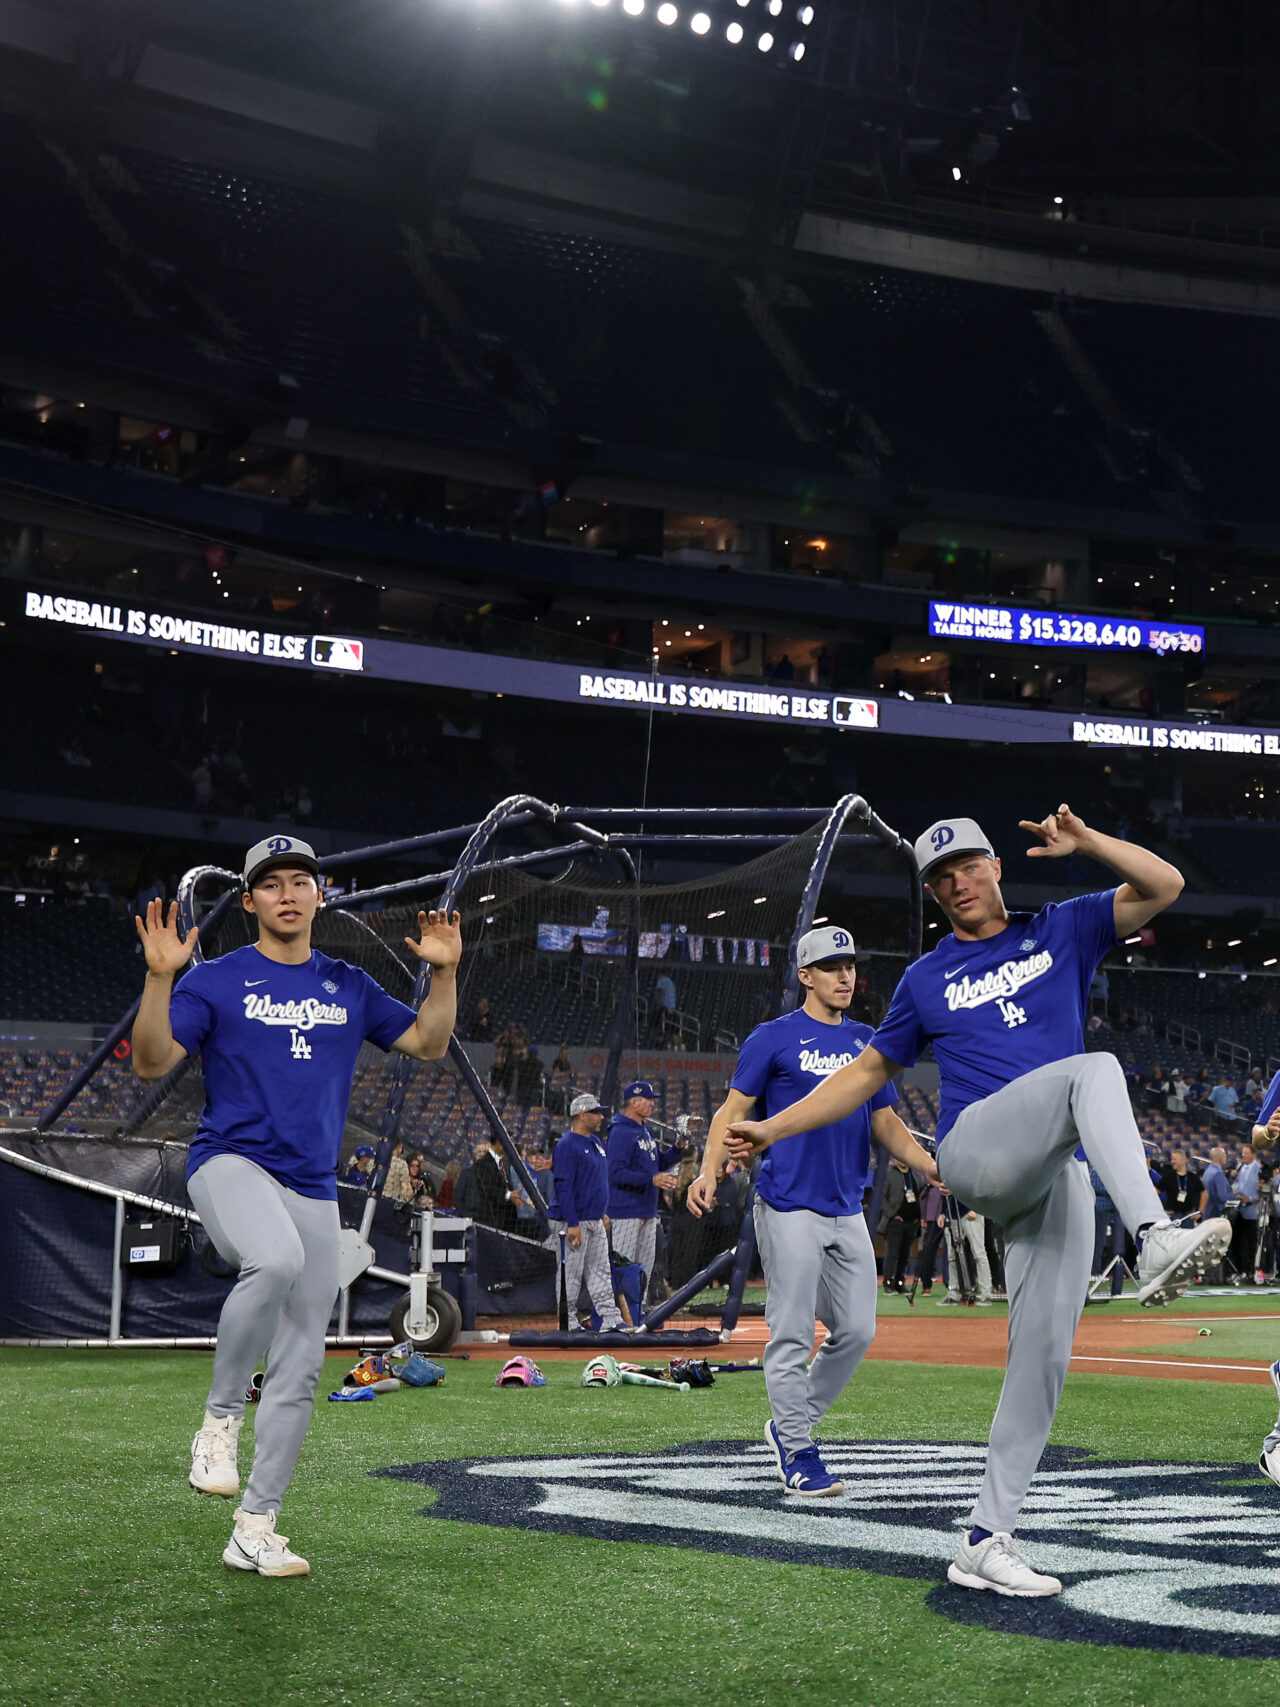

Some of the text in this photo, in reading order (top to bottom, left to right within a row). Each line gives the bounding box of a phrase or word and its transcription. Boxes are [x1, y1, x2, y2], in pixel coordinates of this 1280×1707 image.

[26, 592, 306, 660] BASEBALL IS SOMETHING ELSE
[933, 621, 1013, 640] TAKES HOME
[934, 604, 1012, 628] WINNER
[1019, 613, 1141, 647] $15,328,640
[579, 674, 829, 720] BASEBALL IS SOMETHING ELSE
[1073, 721, 1151, 747] BASEBALL
[1152, 727, 1168, 748] IS
[1170, 729, 1262, 755] SOMETHING
[267, 837, 292, 856] D
[931, 826, 955, 852] D
[832, 931, 849, 948] D
[995, 998, 1027, 1029] LA
[290, 1028, 312, 1060] LA
